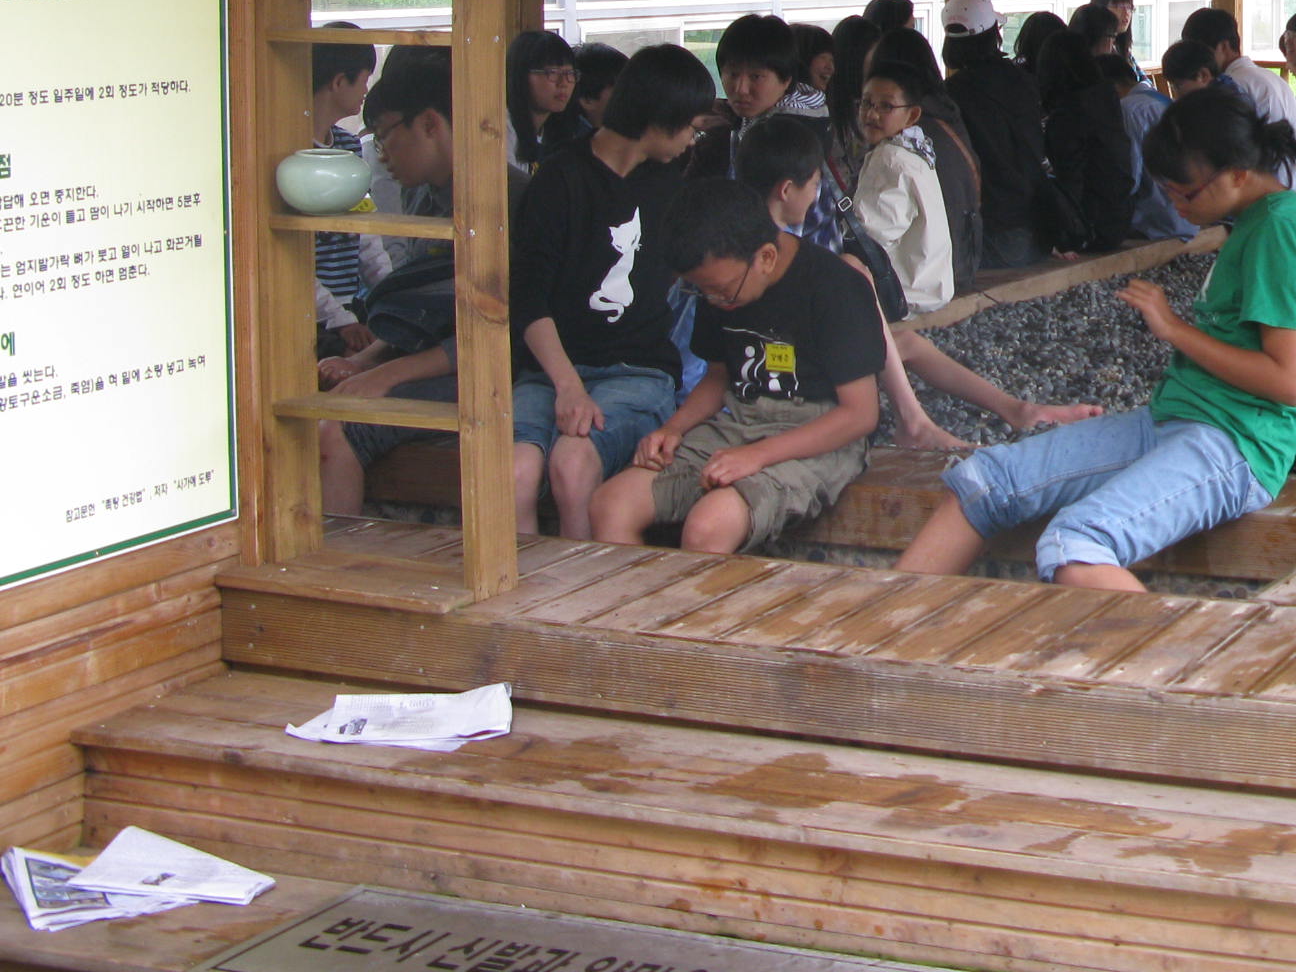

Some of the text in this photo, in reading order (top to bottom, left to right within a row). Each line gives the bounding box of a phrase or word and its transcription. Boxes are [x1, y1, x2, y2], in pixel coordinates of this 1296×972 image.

[28, 89, 49, 106] 정도
[53, 86, 95, 104] 일주일에
[98, 84, 115, 99] 2회
[118, 82, 148, 99] 정도가
[151, 79, 191, 95] 적당하다.
[0, 184, 99, 210] 답해 오면 중지한다.
[0, 192, 201, 233] 끈한 기운이 들고 땀이 나기 시작하면 5분후
[16, 253, 70, 276] 엄지발가락
[73, 250, 94, 266] 뼈가
[121, 243, 140, 260] 열이
[144, 239, 162, 254] 나고
[12, 279, 45, 300] 연이어
[49, 275, 67, 293] 2회
[71, 272, 91, 290] 정도
[95, 268, 115, 285] 하면
[22, 364, 58, 385] 씻는다.
[298, 917, 453, 963] 반드시
